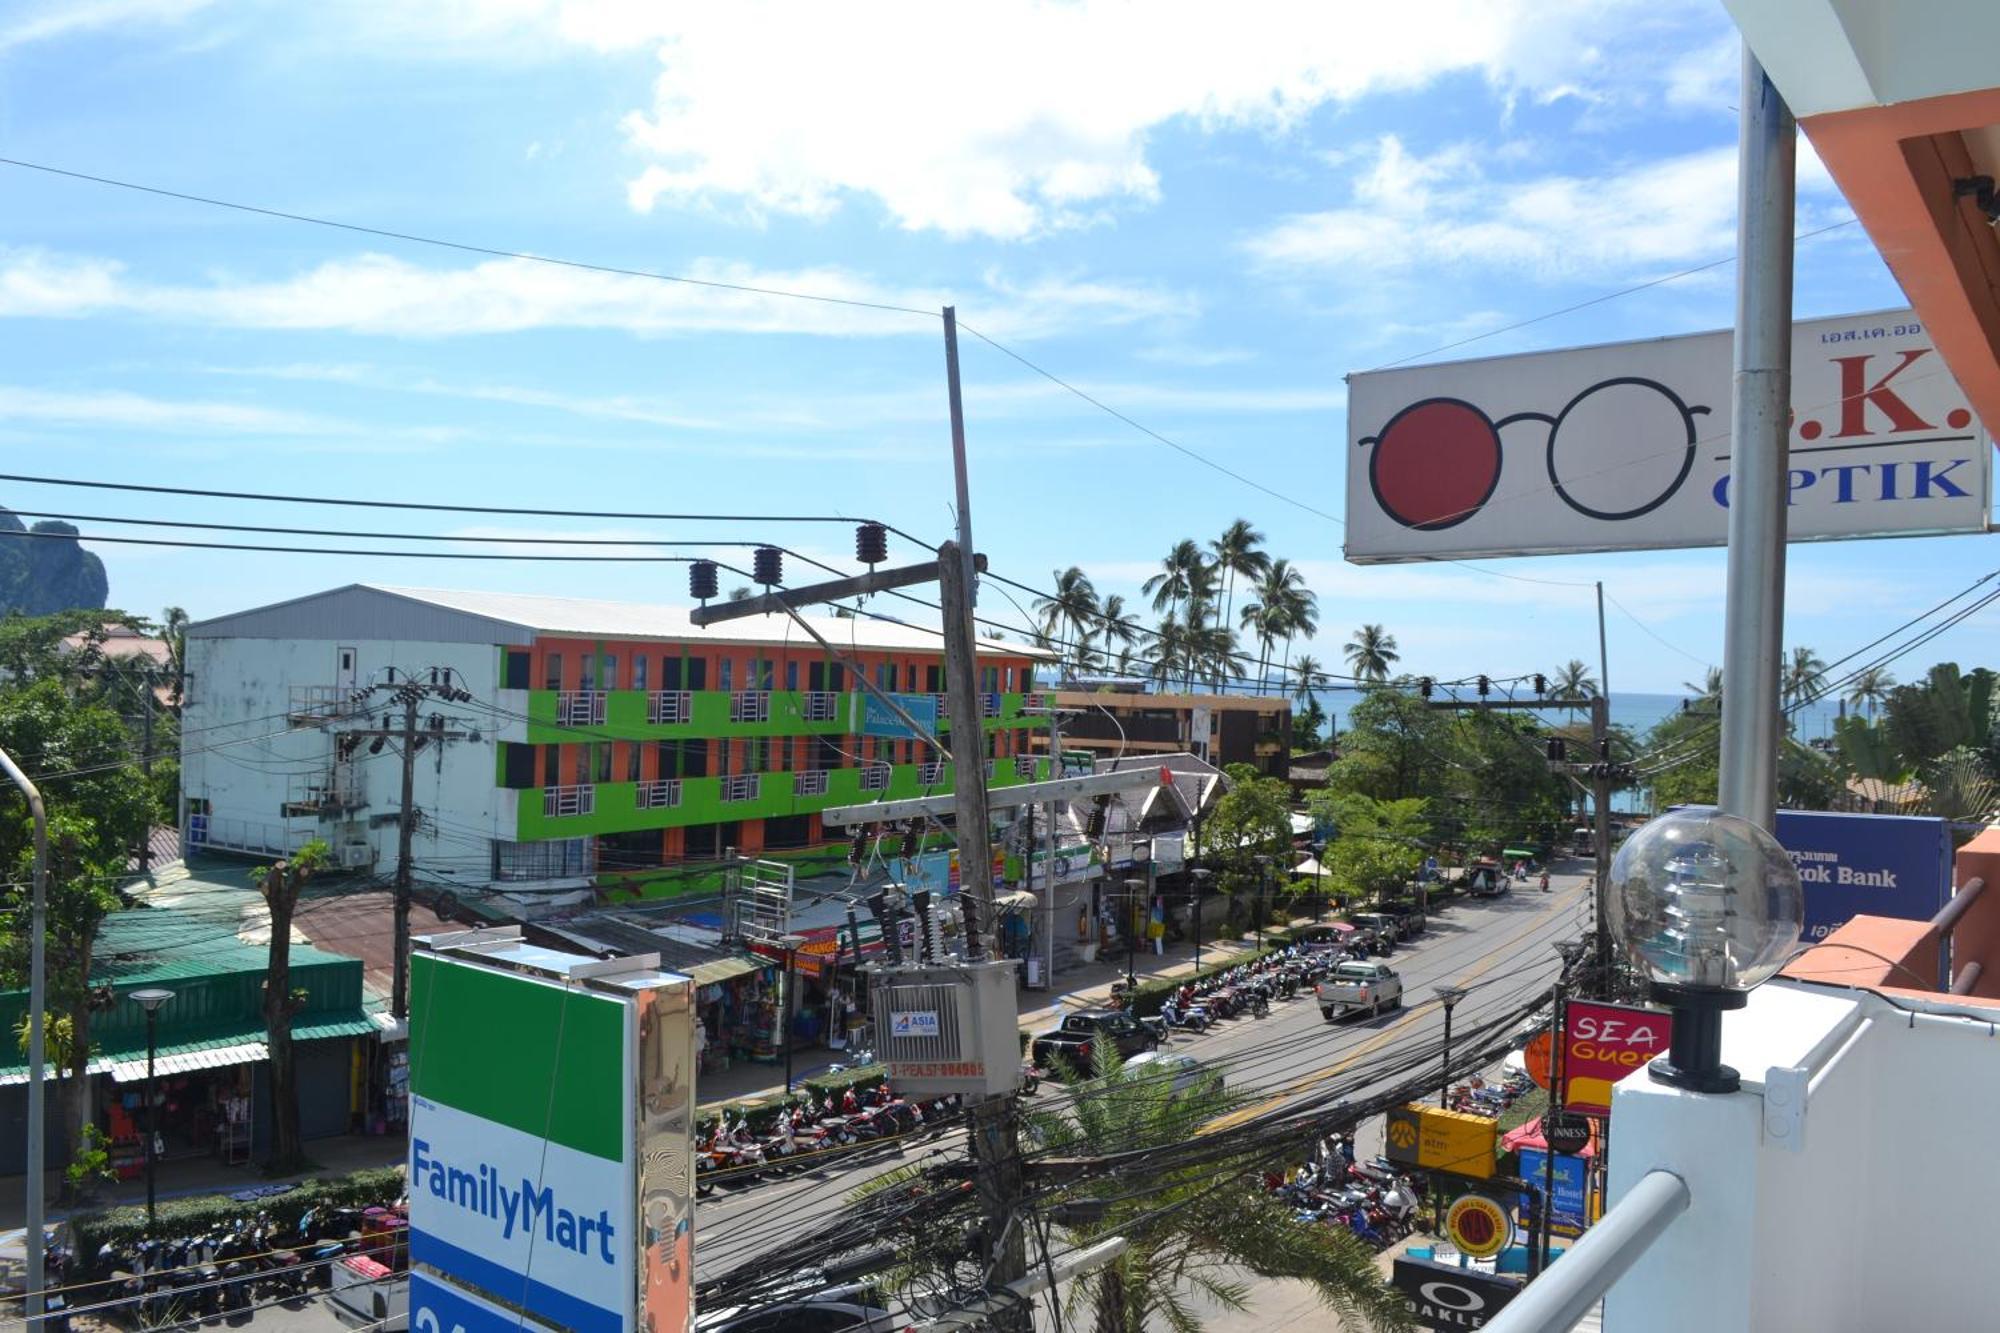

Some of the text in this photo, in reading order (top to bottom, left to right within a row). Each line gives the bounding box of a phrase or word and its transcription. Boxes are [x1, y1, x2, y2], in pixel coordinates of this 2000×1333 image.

[1790, 348, 1972, 440] .K.
[1837, 866, 1897, 888] Bank
[911, 1015, 936, 1026] ASIA
[1573, 1017, 1659, 1048] SEA
[1543, 1126, 1587, 1139] INNESS
[413, 1137, 615, 1265] FamilyMart
